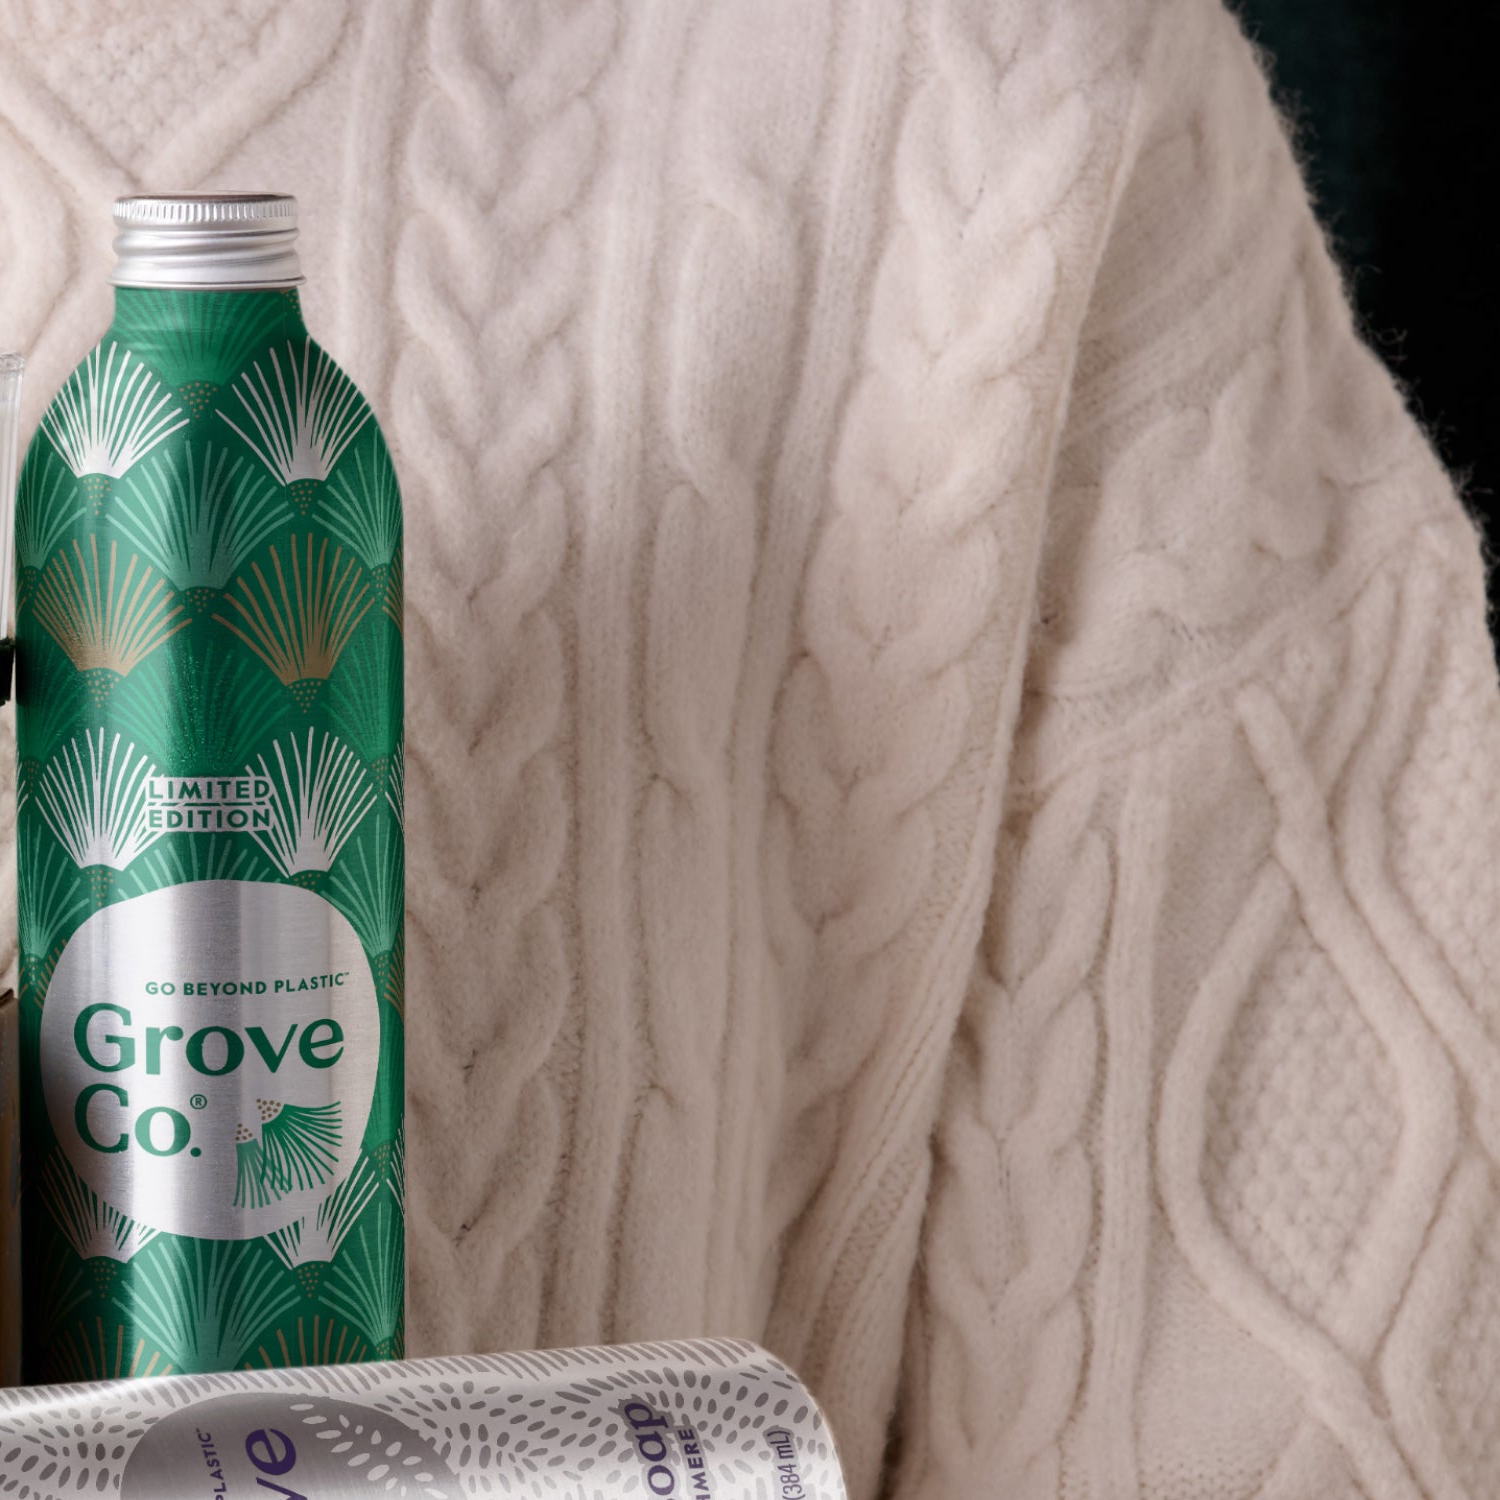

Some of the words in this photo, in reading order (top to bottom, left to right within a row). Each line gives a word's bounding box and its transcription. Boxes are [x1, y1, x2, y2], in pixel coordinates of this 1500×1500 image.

[148, 779, 270, 800] LIMITED
[148, 808, 271, 829] EDITION
[145, 981, 176, 996] GO
[183, 981, 267, 996] BEYOND
[73, 1003, 345, 1077] Grove
[766, 1429, 793, 1459] mL)
